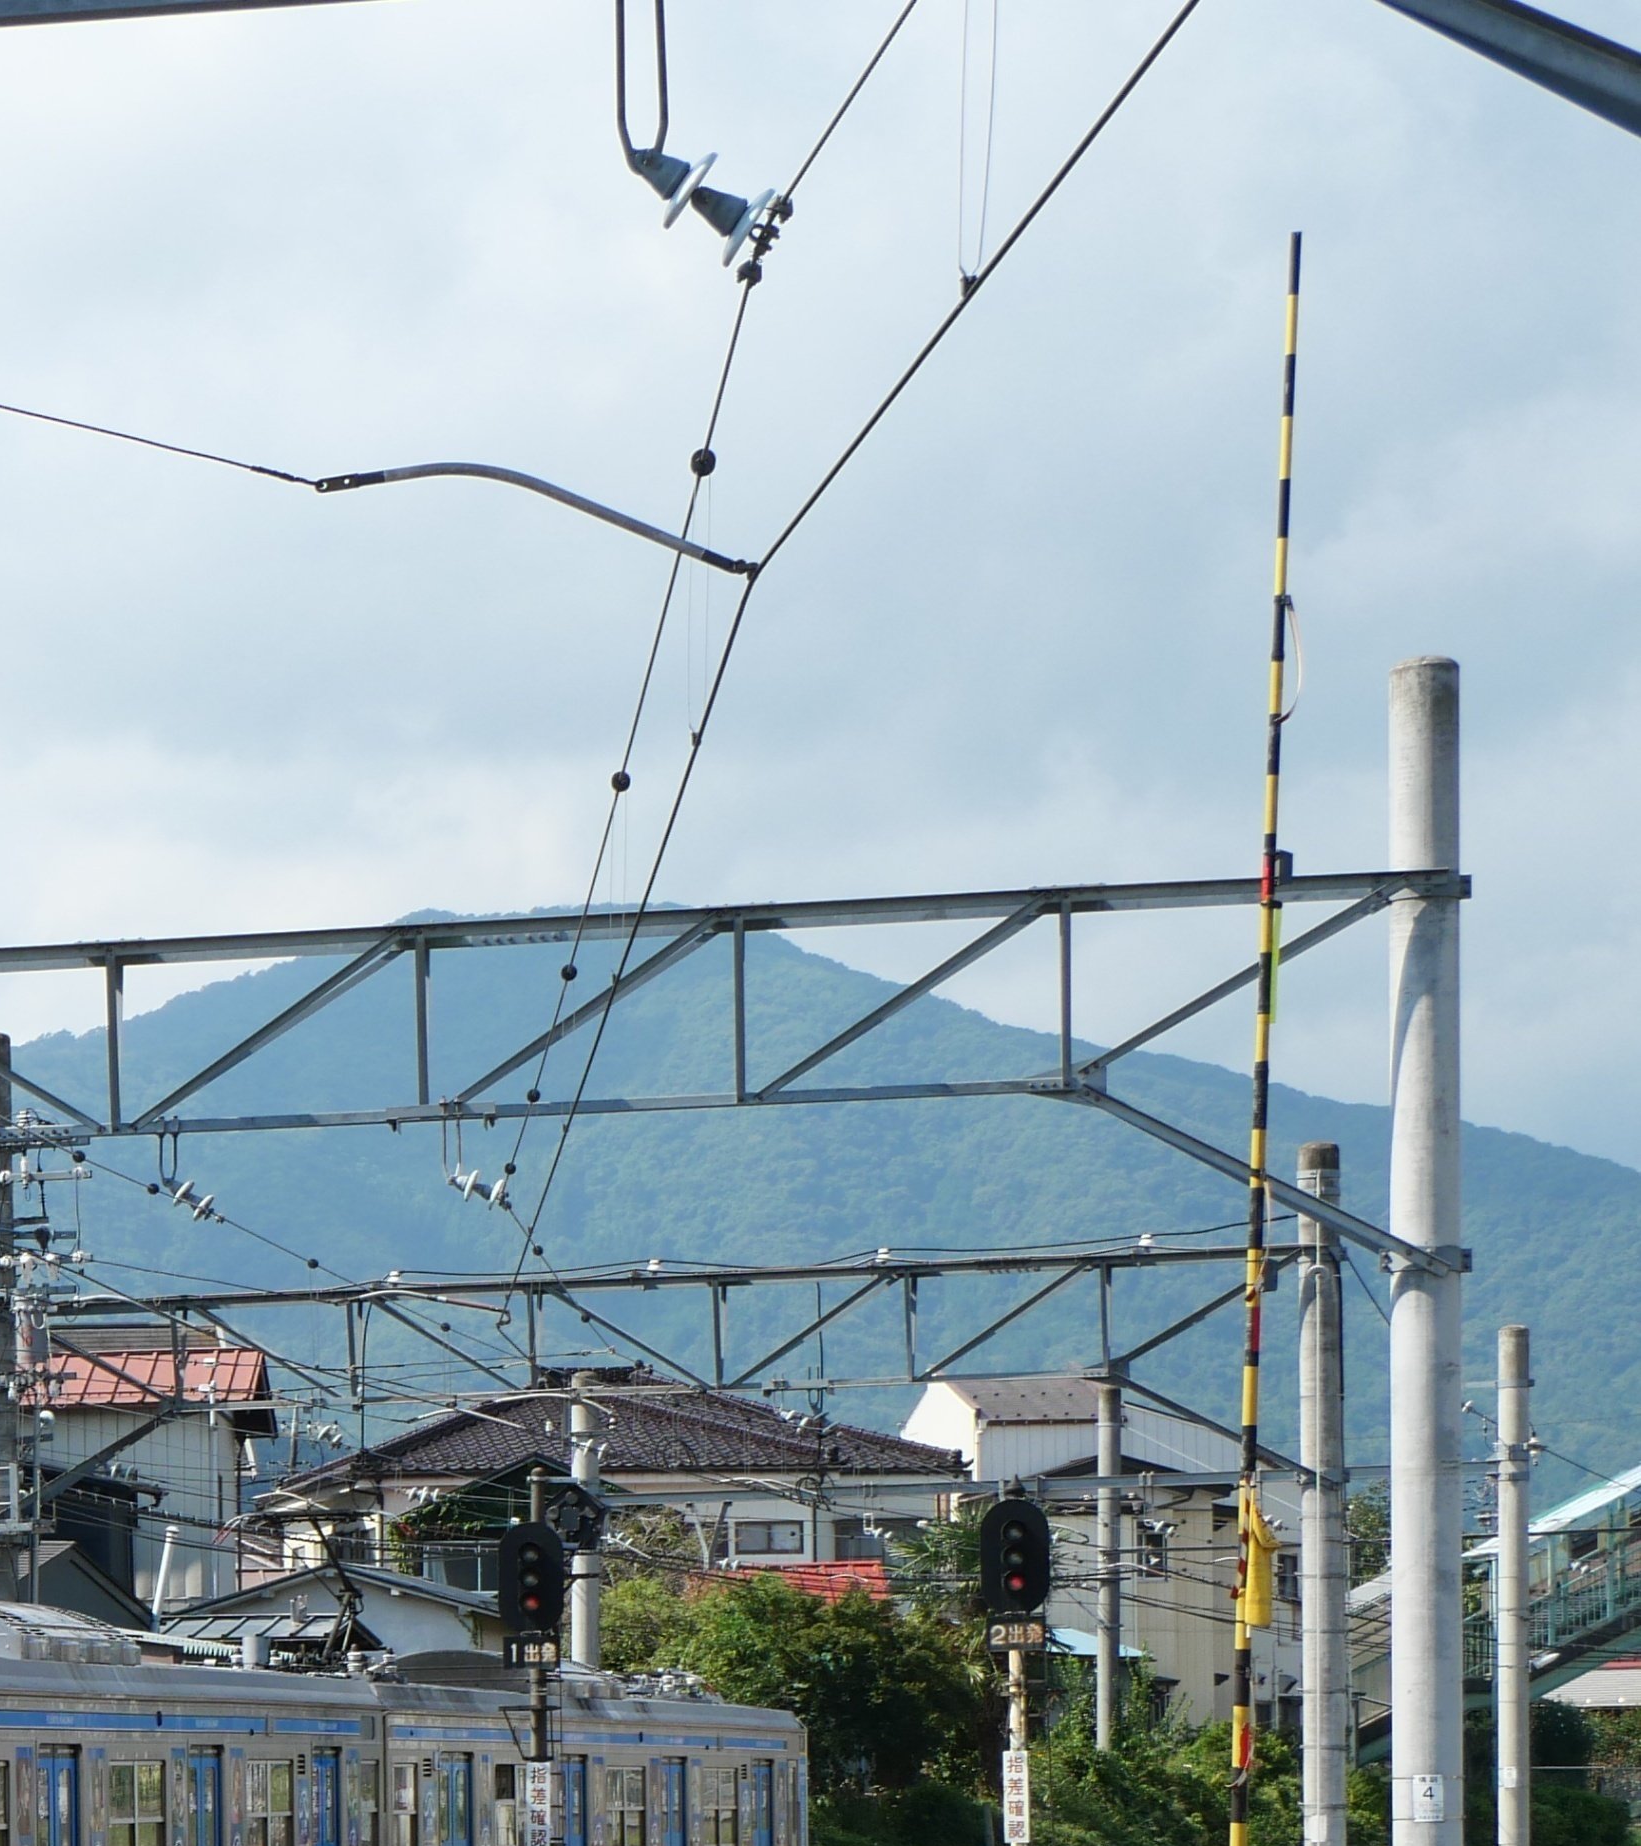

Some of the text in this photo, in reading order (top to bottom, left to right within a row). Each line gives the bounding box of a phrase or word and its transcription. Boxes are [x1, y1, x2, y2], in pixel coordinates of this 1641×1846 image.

[530, 1766, 547, 1846] 指差確認
[1422, 1786, 1435, 1801] 4
